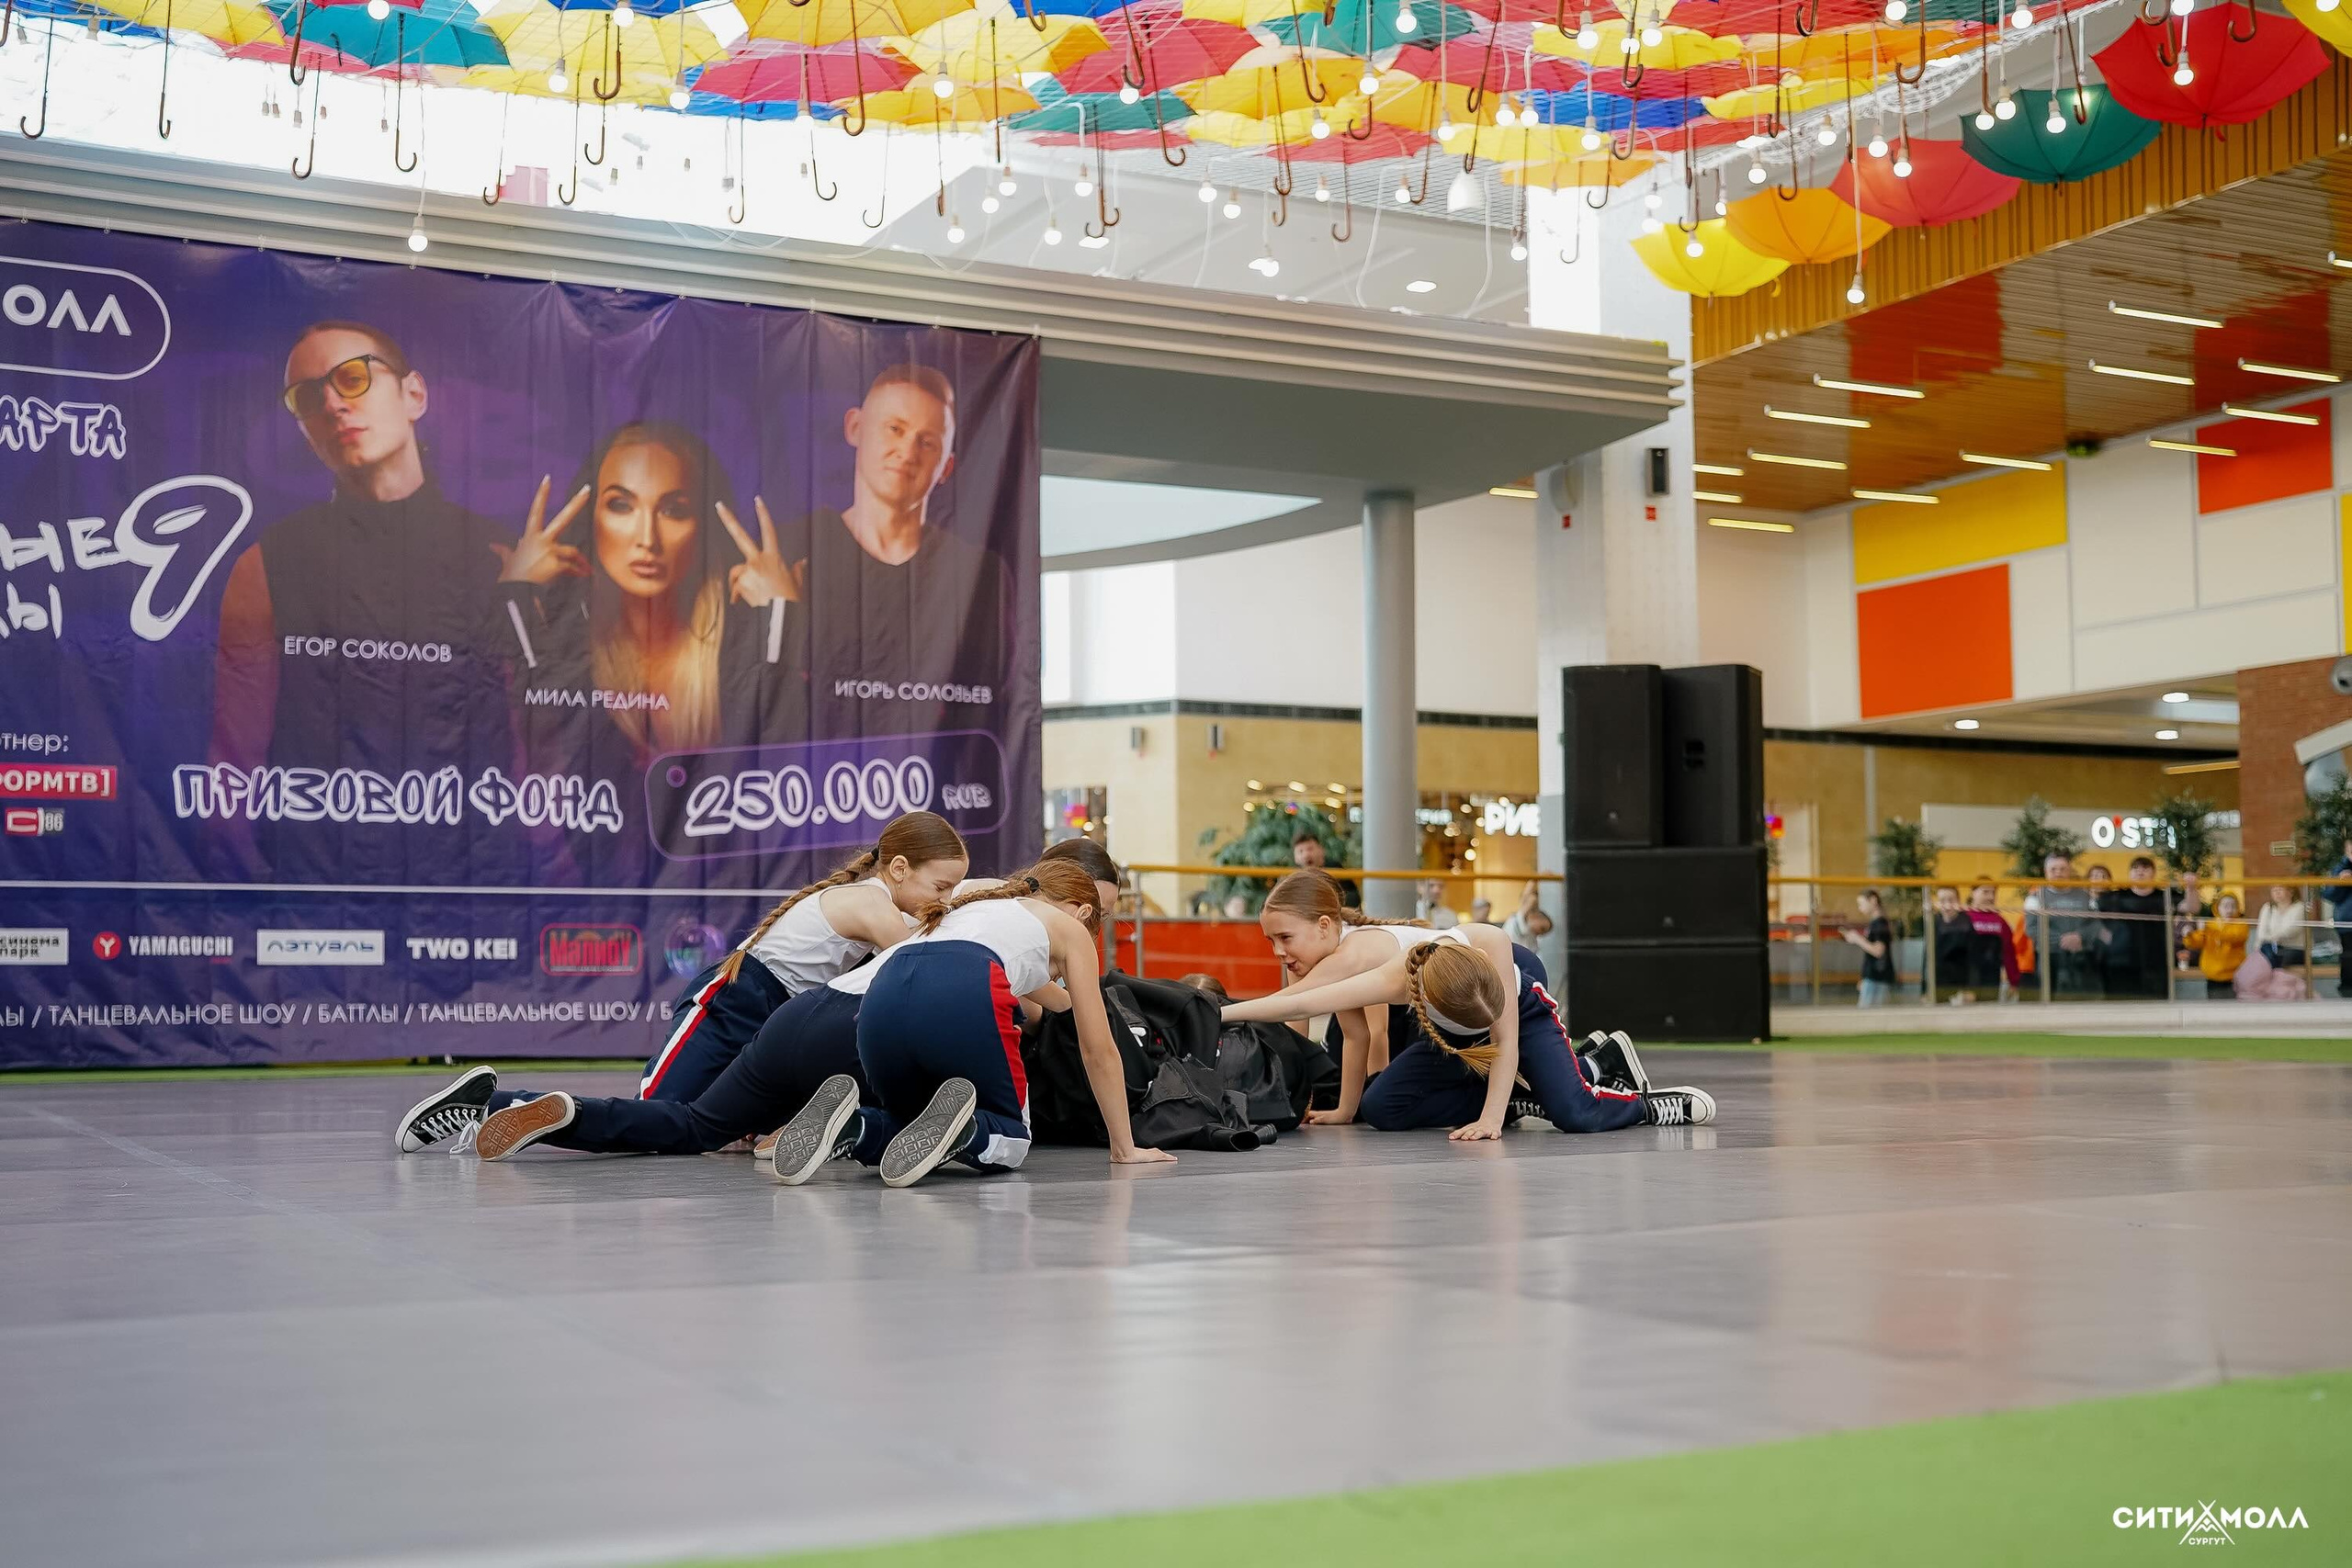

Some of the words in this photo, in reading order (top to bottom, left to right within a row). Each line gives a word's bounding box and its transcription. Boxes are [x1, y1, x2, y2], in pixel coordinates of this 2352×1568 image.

[284, 635, 336, 658] ЕГОР
[342, 638, 452, 663] СОКОЛОВ
[525, 688, 587, 709] МИЛА
[591, 690, 670, 712] РЕДИНА
[834, 679, 896, 700] ИГОРЬ
[898, 682, 994, 705] СОЛОВЬЕВ
[0, 732, 69, 756] тнер:
[173, 762, 463, 825] ПРИЗОВОЙ
[469, 766, 624, 834] ФОНД
[684, 755, 934, 838] 250.000
[941, 783, 993, 811] RUB
[128, 935, 234, 957] YAMAGUCHI
[406, 937, 470, 960] TWO
[473, 938, 519, 961] KEI
[0, 1005, 25, 1027] Ы
[49, 1004, 234, 1029] ТАНЦЕВАЛЬНОЕ
[239, 1002, 297, 1026] ШОУ
[318, 1003, 400, 1024] БАТТЛЫ
[418, 1001, 585, 1025] ТАНЦЕВАЛЬНОЕ
[589, 1000, 642, 1021] ШОУ
